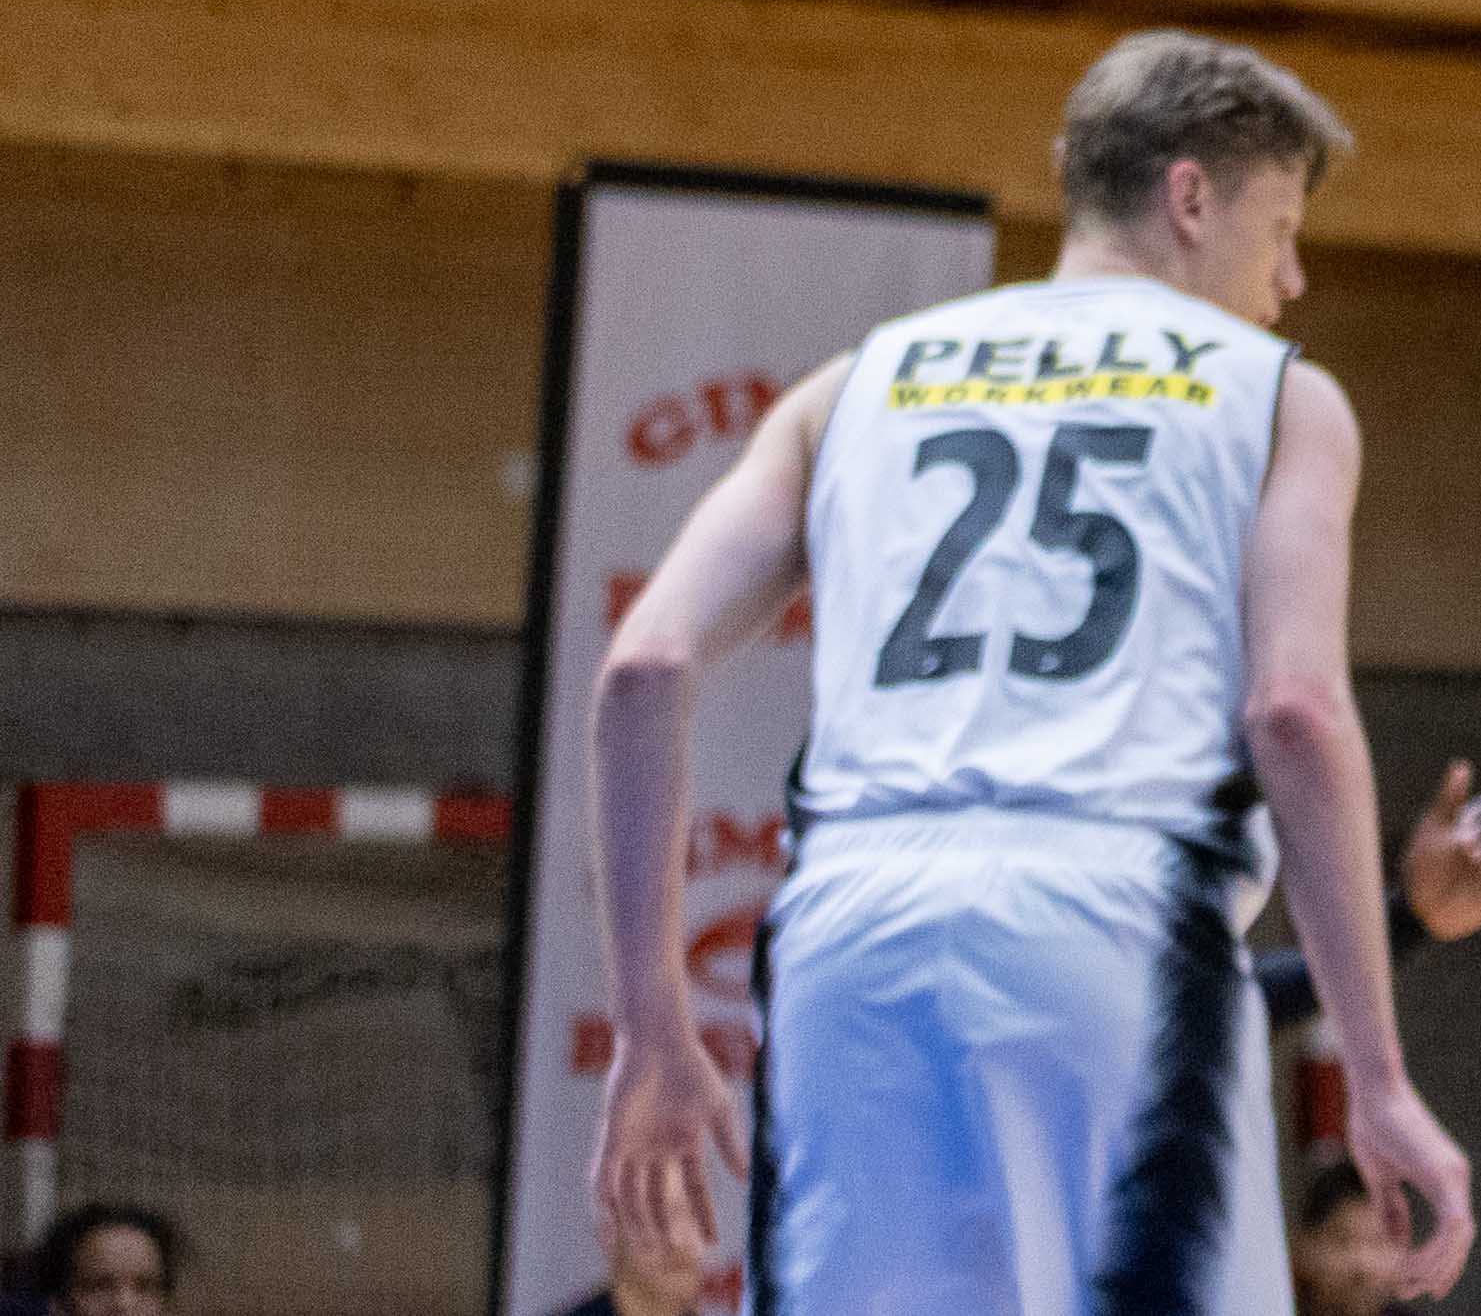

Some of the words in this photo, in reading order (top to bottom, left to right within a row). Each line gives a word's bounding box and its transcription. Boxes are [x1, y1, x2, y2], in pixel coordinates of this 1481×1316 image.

[894, 331, 1225, 385] PELLY
[893, 375, 1213, 406] WORKWEAR
[873, 420, 1156, 689] 25
